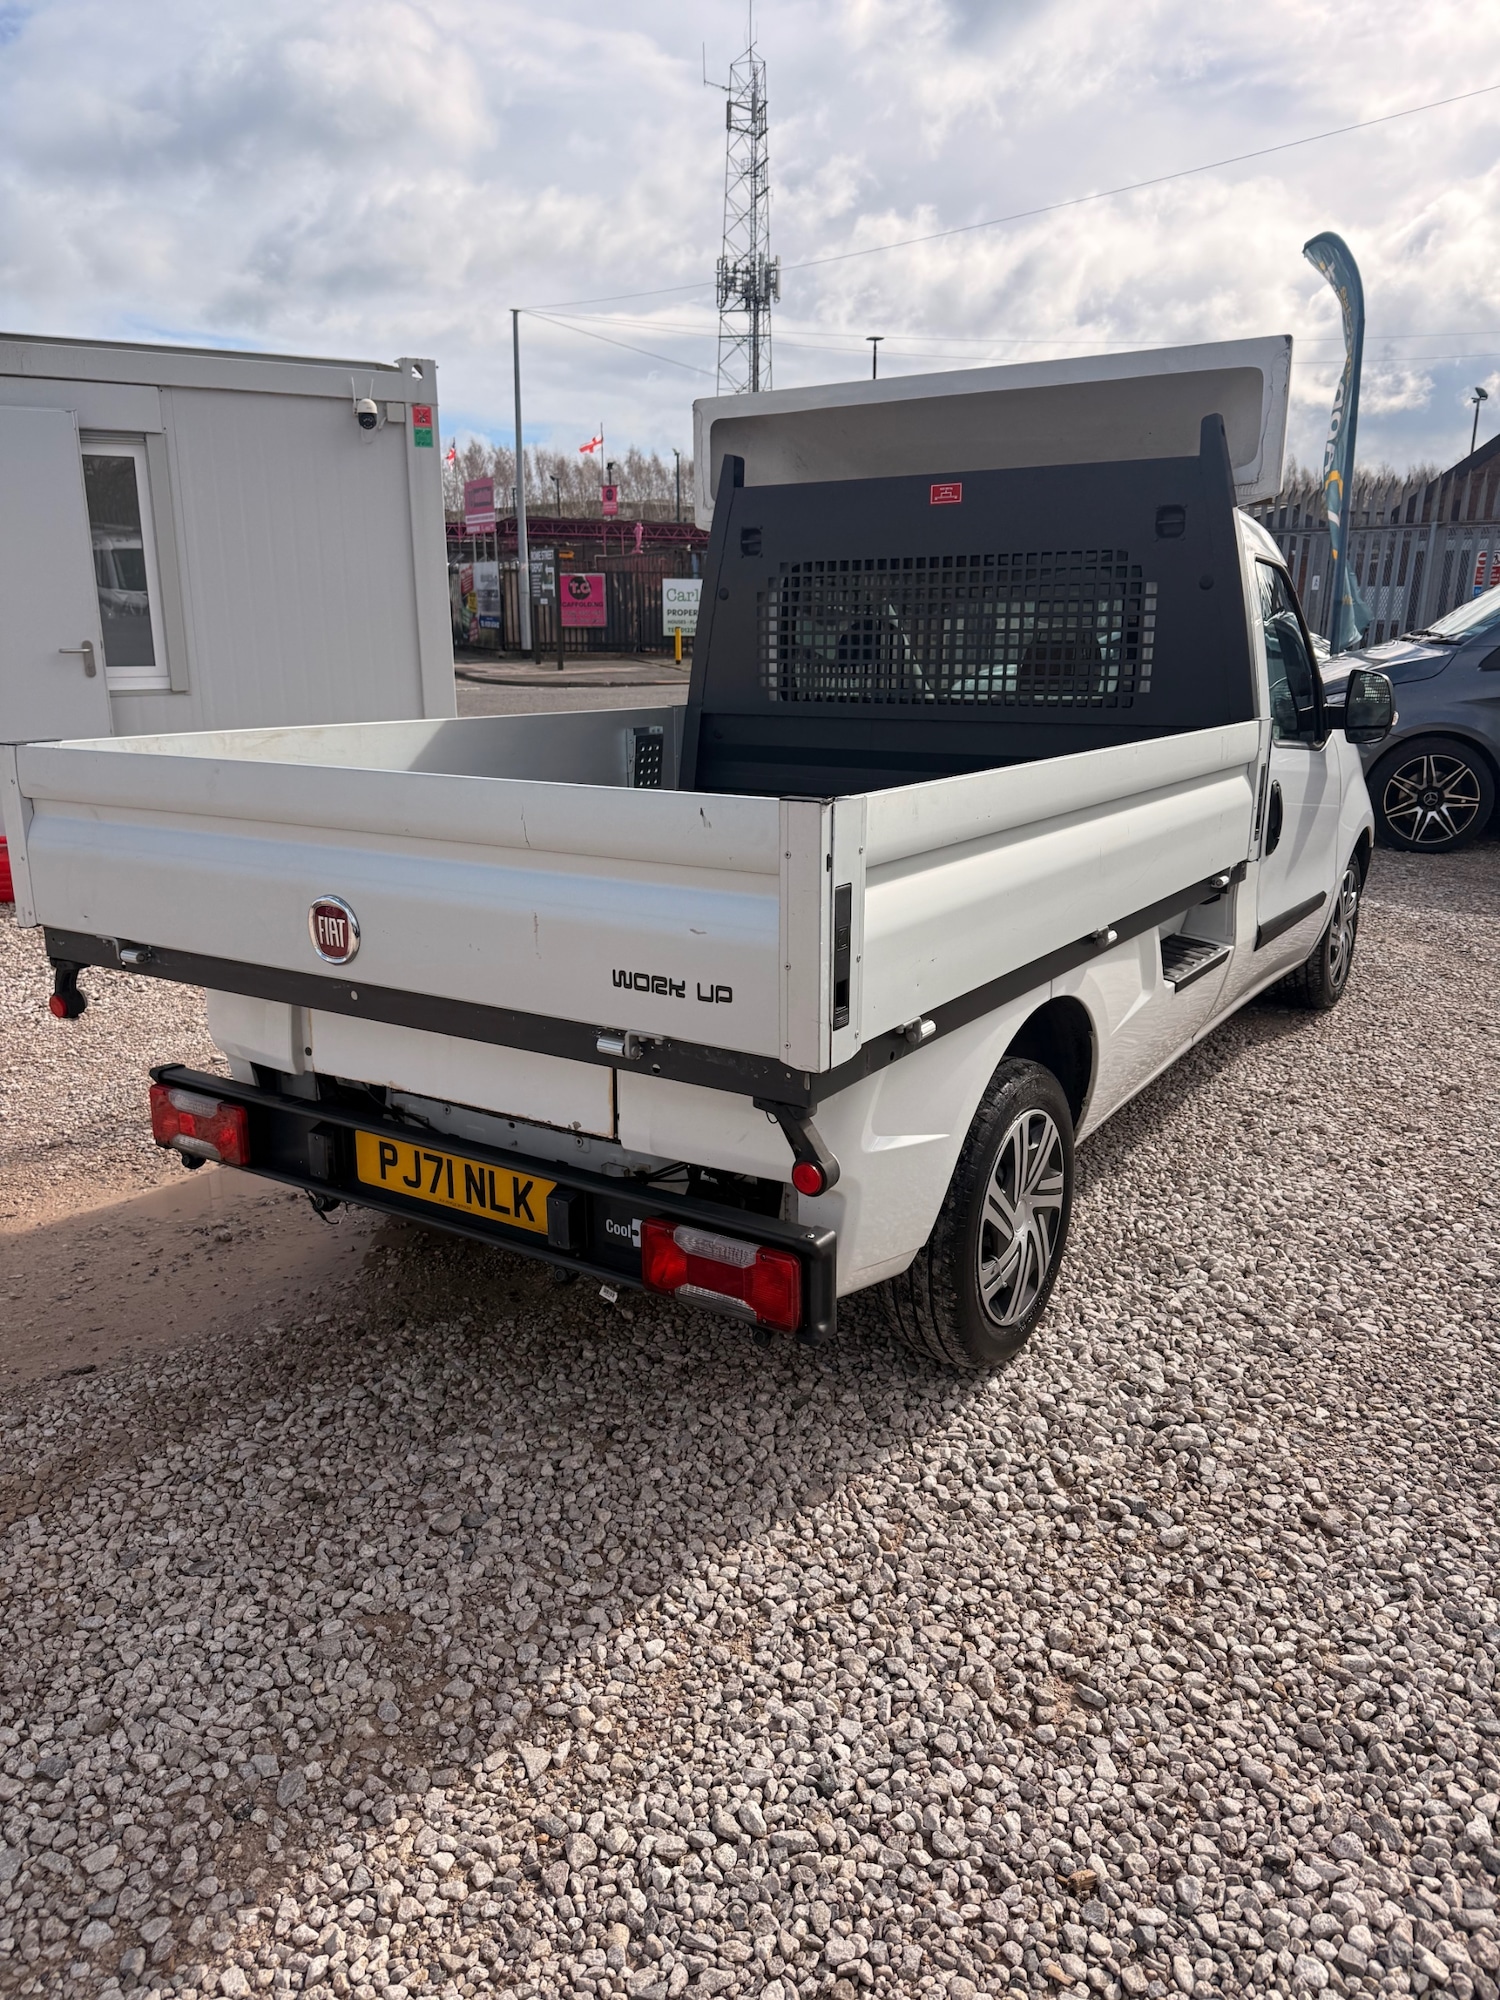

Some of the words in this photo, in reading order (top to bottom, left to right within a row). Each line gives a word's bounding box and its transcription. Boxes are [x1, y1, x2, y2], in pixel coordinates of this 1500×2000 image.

[318, 915, 346, 948] FIAT
[612, 969, 686, 998] WORK
[697, 982, 733, 1003] UP
[378, 1140, 455, 1200] PJ71
[464, 1163, 535, 1223] NLK
